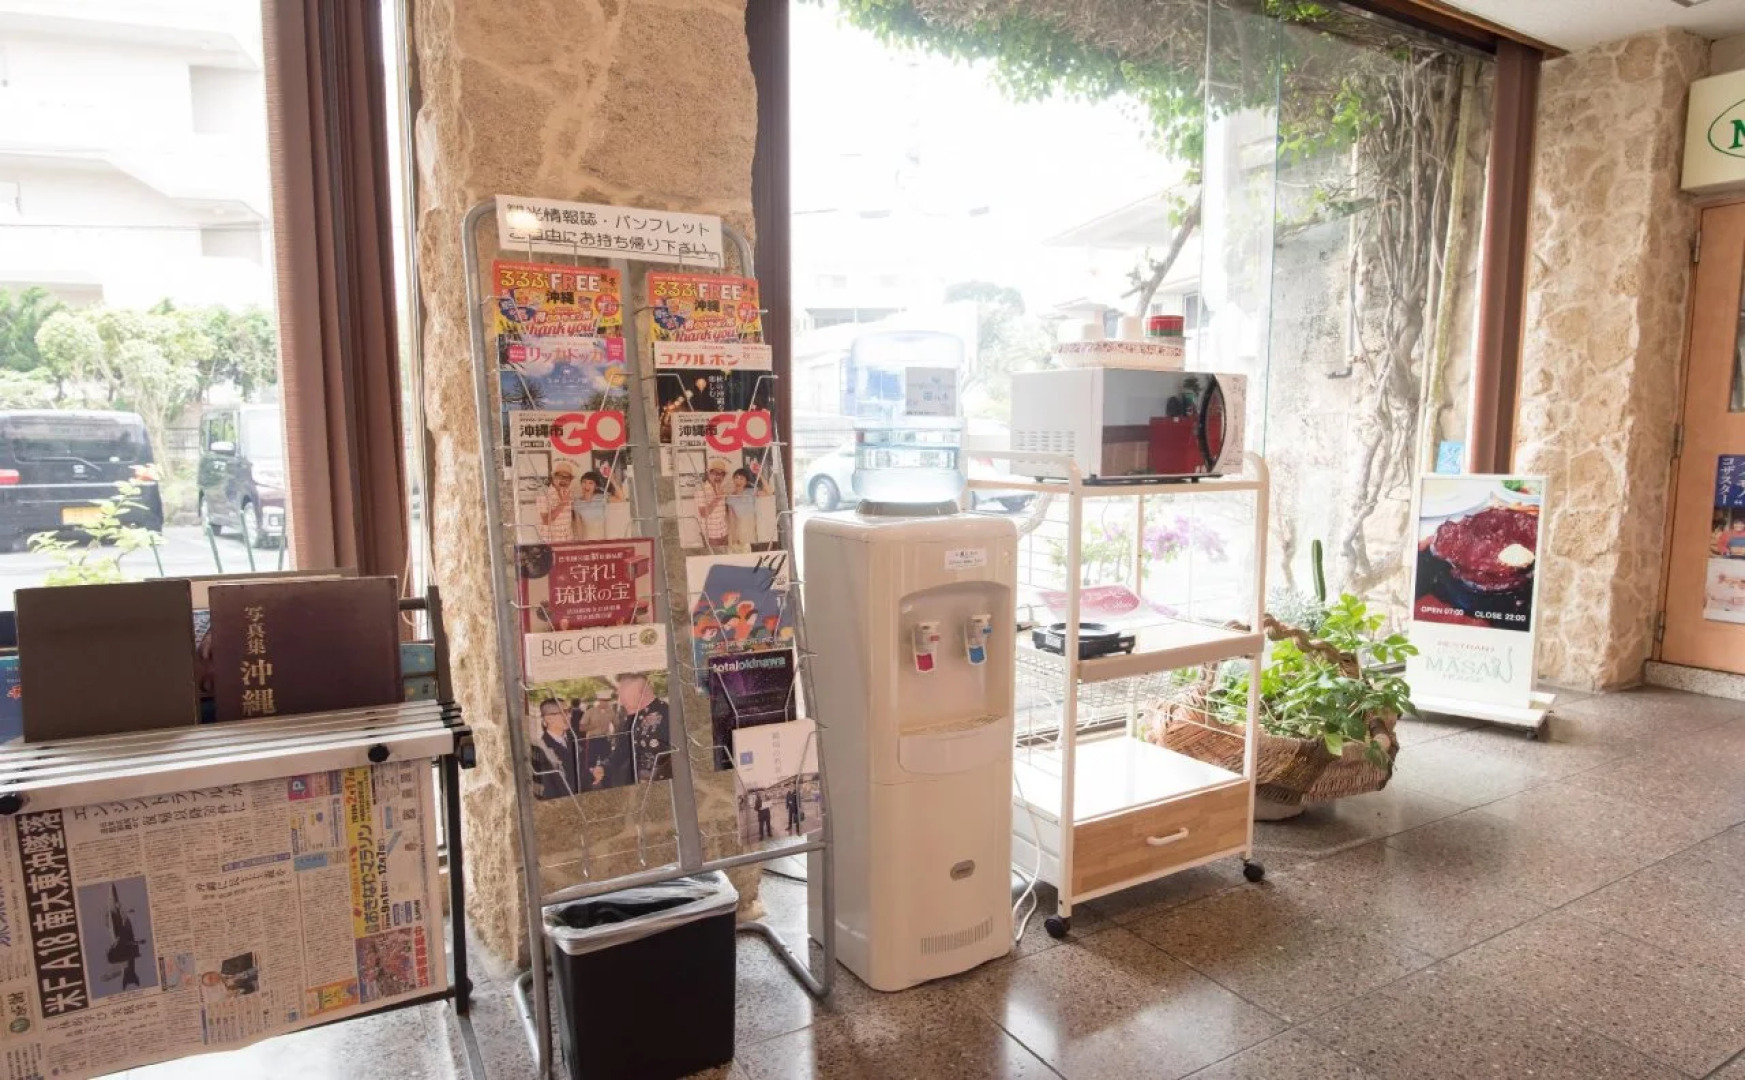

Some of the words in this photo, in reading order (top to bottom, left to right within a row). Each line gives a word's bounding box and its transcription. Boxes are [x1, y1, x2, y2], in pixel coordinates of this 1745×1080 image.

[519, 424, 564, 438] 沖縄市
[550, 411, 627, 454] GO
[706, 411, 772, 453] GO
[555, 581, 631, 605] 琉球の宝
[1421, 606, 1442, 615] OPEN
[1474, 611, 1502, 620] CLOSE
[244, 606, 266, 654] 写真集
[541, 639, 573, 657] BIG
[577, 632, 638, 653] CIRCLE
